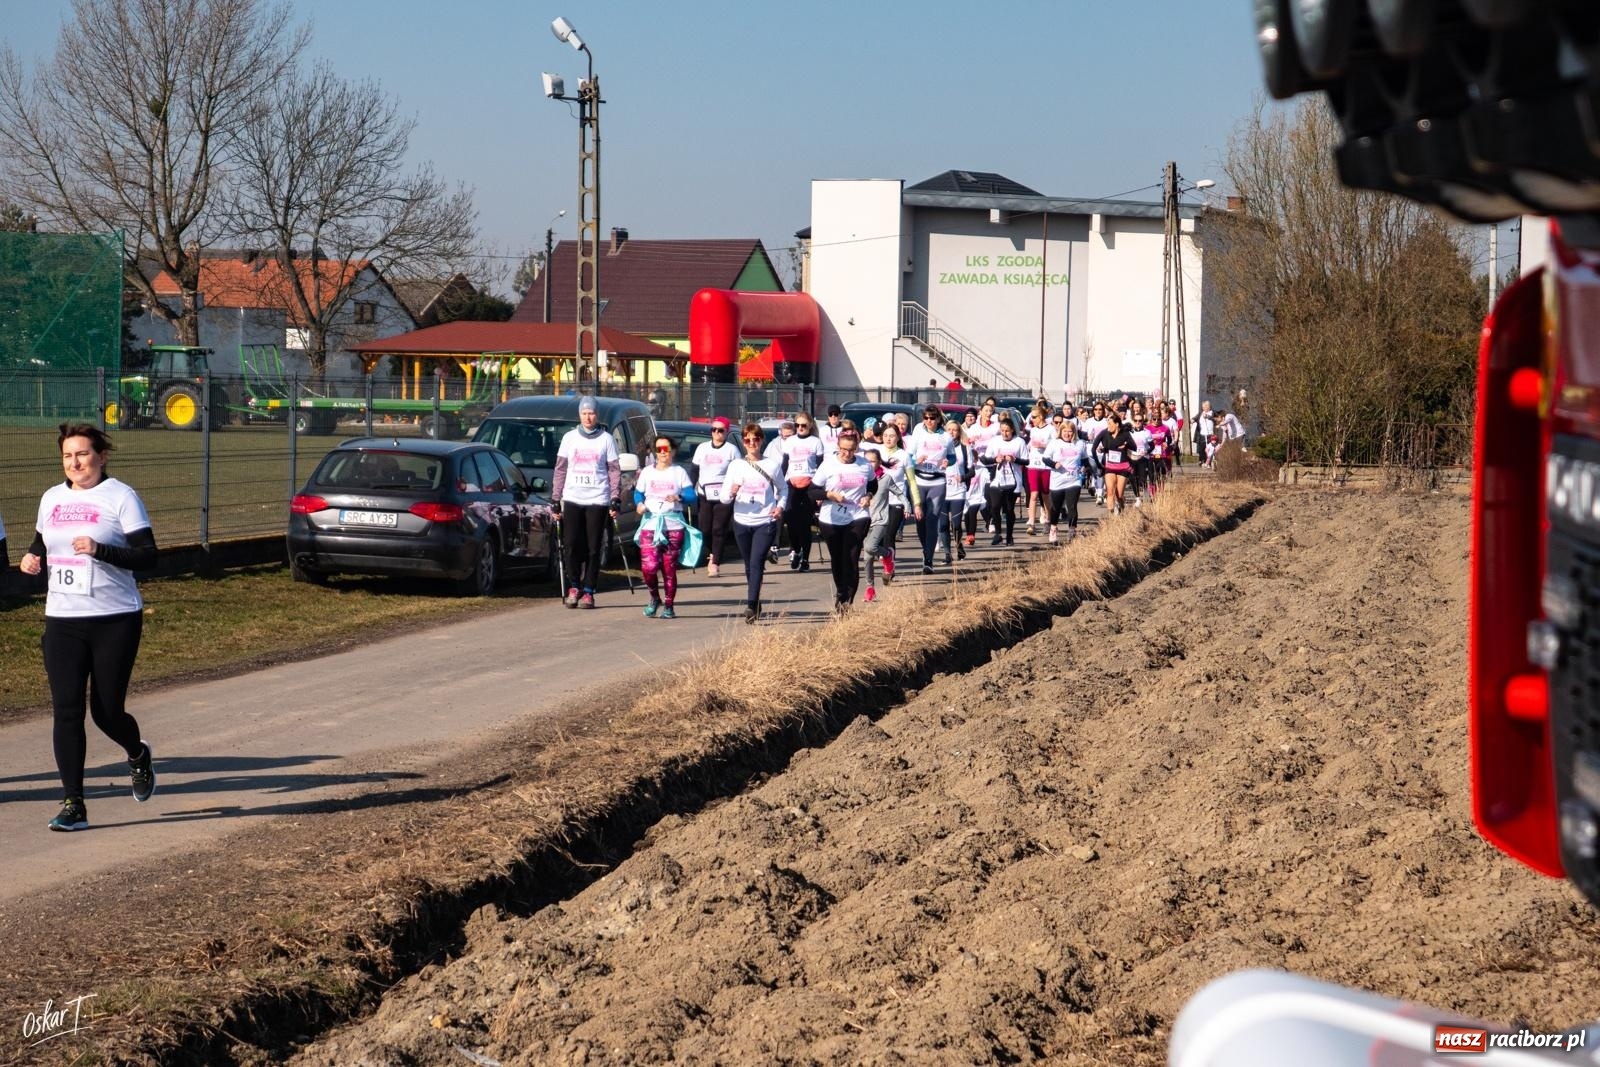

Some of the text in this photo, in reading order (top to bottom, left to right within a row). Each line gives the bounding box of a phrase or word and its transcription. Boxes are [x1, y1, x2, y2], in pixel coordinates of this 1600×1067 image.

[966, 255, 1044, 267] LKS ZGODA
[939, 271, 1070, 288] ZAWADA KSIĄŻĘCA
[575, 475, 591, 485] 113
[658, 501, 664, 510] 7
[58, 512, 94, 522] KOBIET
[346, 511, 394, 524] SRC AY35
[56, 568, 74, 586] 18
